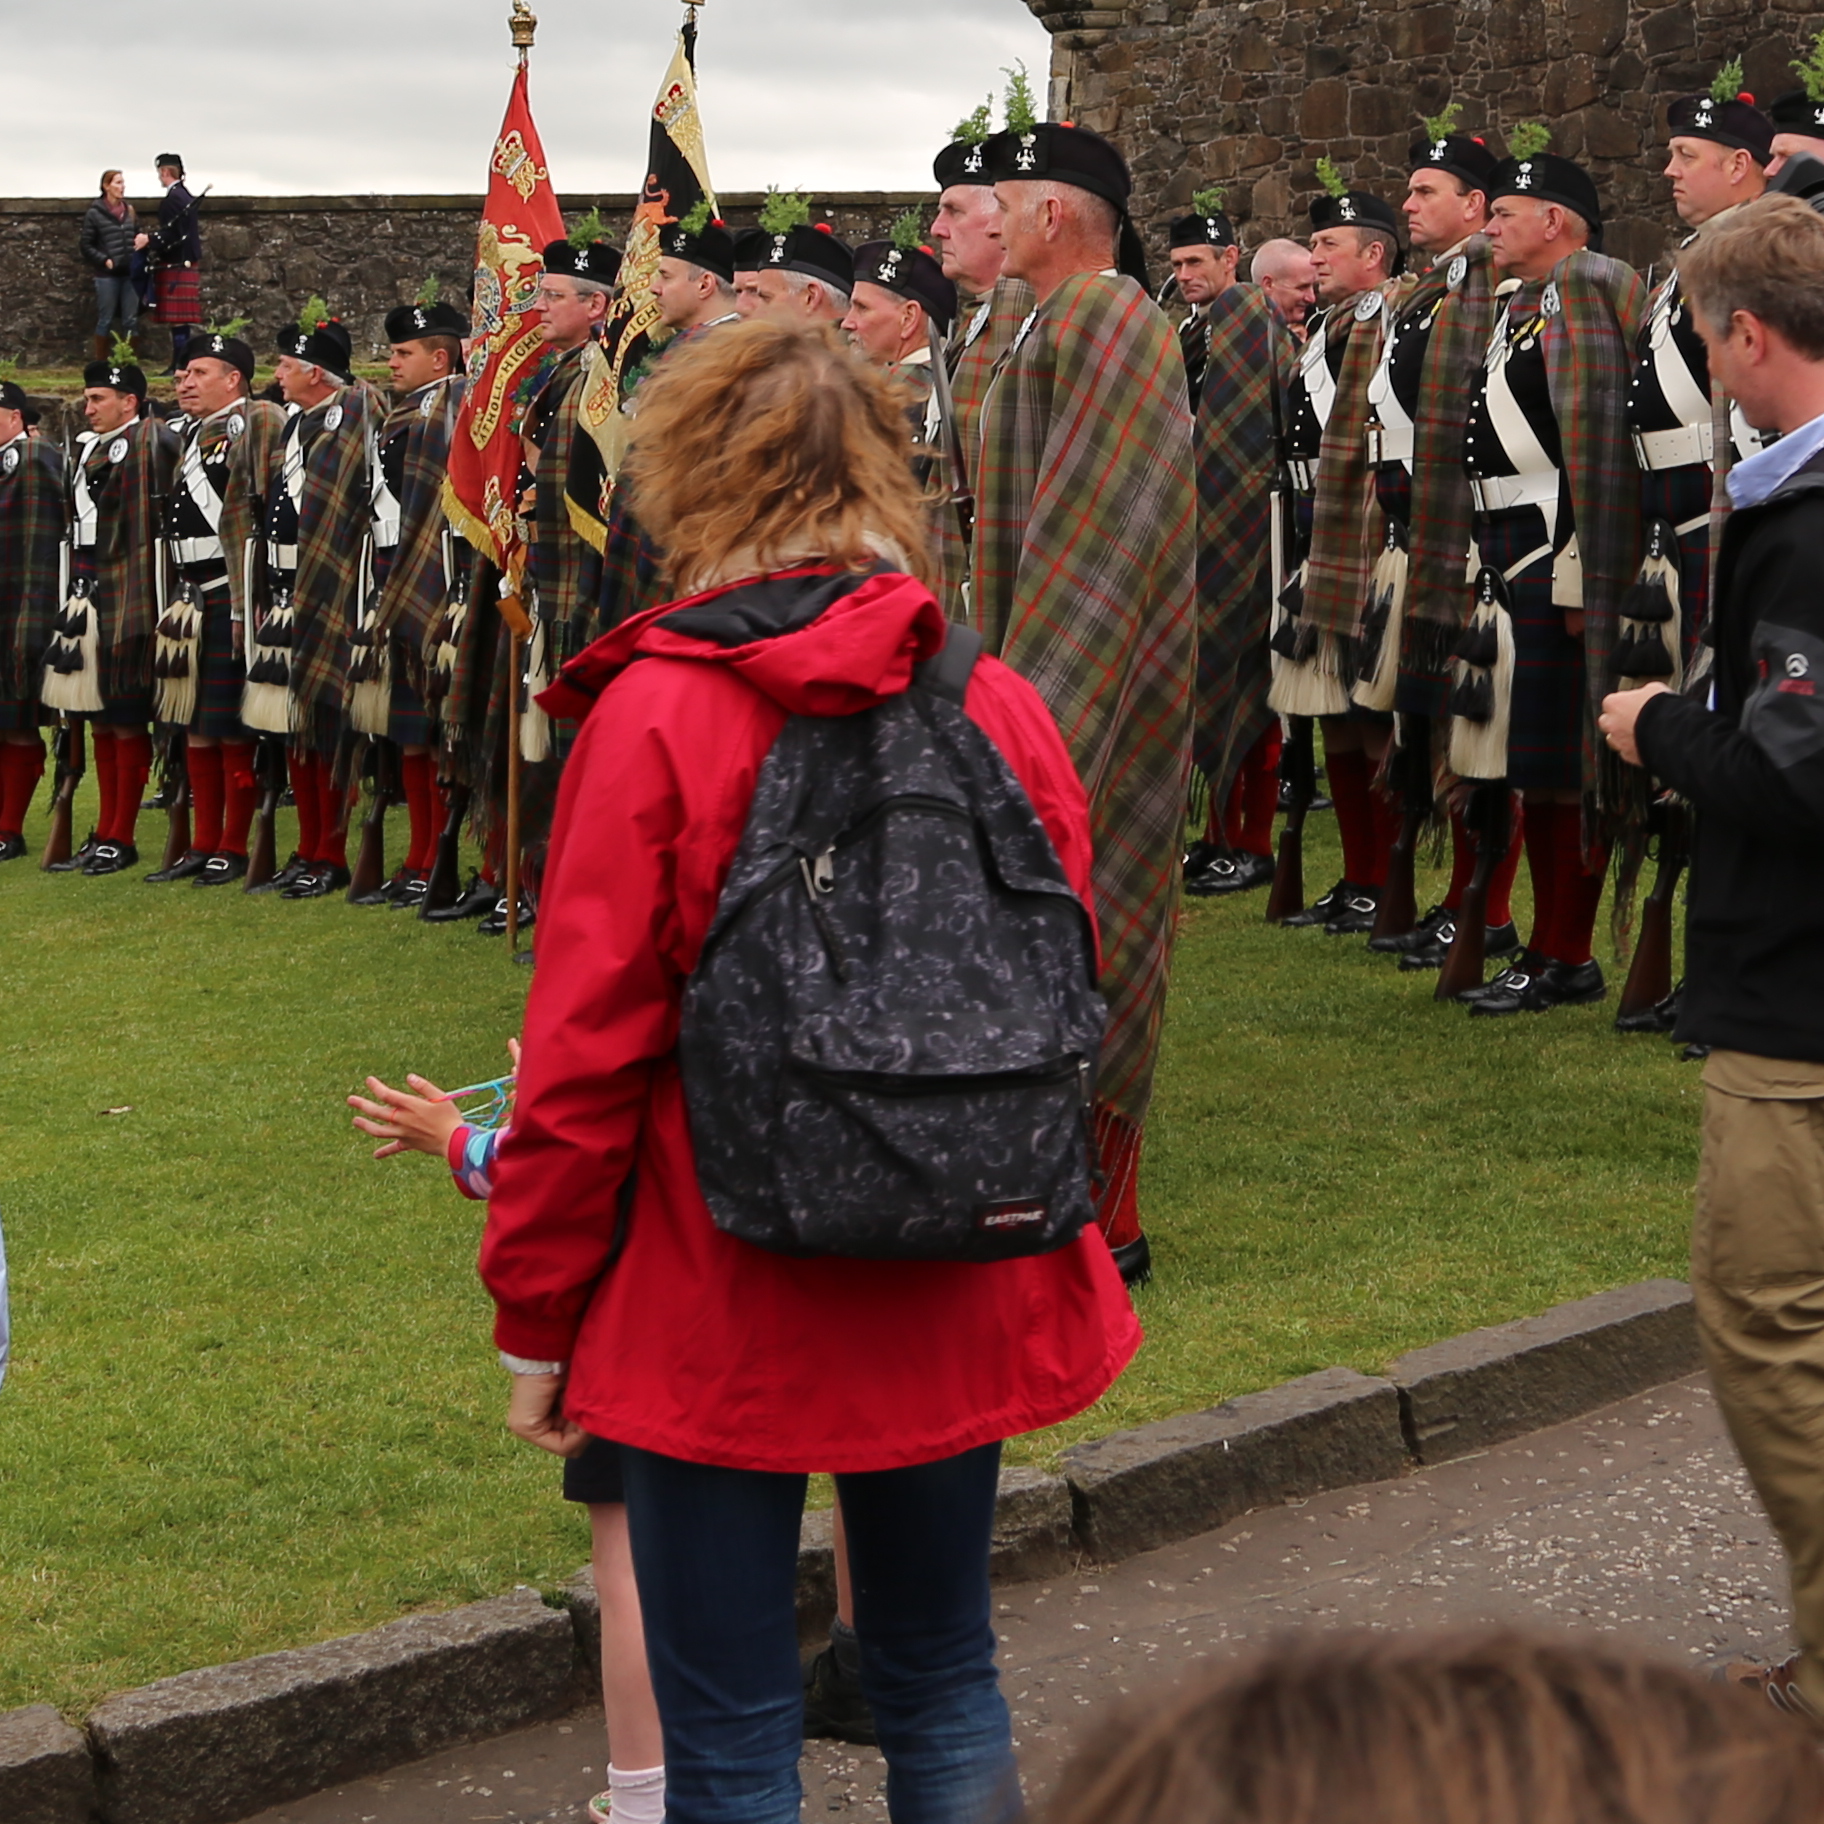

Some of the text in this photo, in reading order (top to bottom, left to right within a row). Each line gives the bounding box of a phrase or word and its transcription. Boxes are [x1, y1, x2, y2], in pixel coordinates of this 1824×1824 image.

[623, 304, 660, 344] HIGH
[478, 380, 504, 444] ATHOLL
[501, 331, 542, 375] HIGHL
